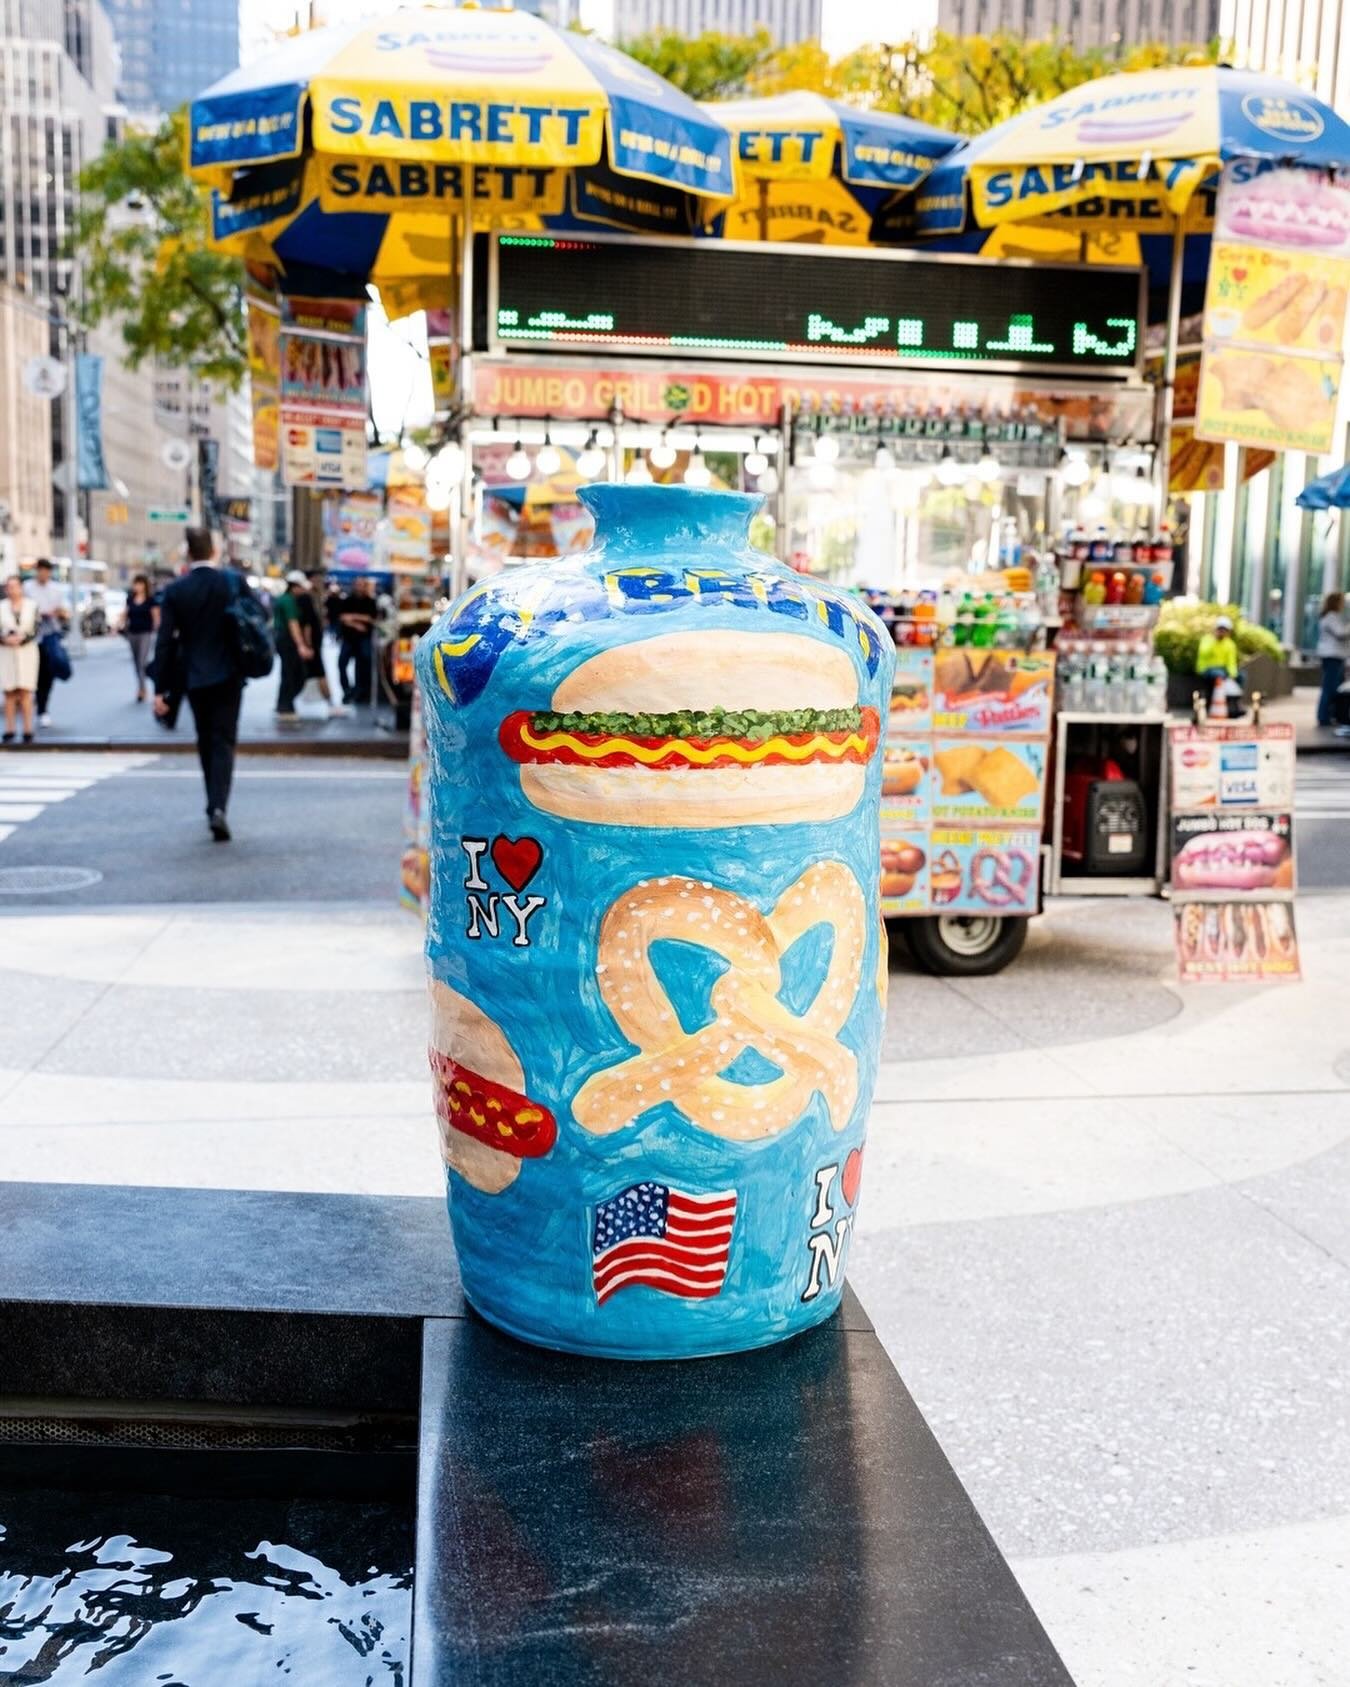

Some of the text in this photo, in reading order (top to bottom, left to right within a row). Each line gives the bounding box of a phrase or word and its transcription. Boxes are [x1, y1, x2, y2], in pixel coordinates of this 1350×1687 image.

[330, 98, 590, 145] SABRETT
[330, 163, 554, 200] SABRETT
[489, 376, 585, 407] JUMBO
[718, 384, 777, 416] HOT
[461, 836, 489, 892] I
[467, 892, 547, 947] NY
[810, 1162, 840, 1230] I
[800, 1212, 854, 1303] N
